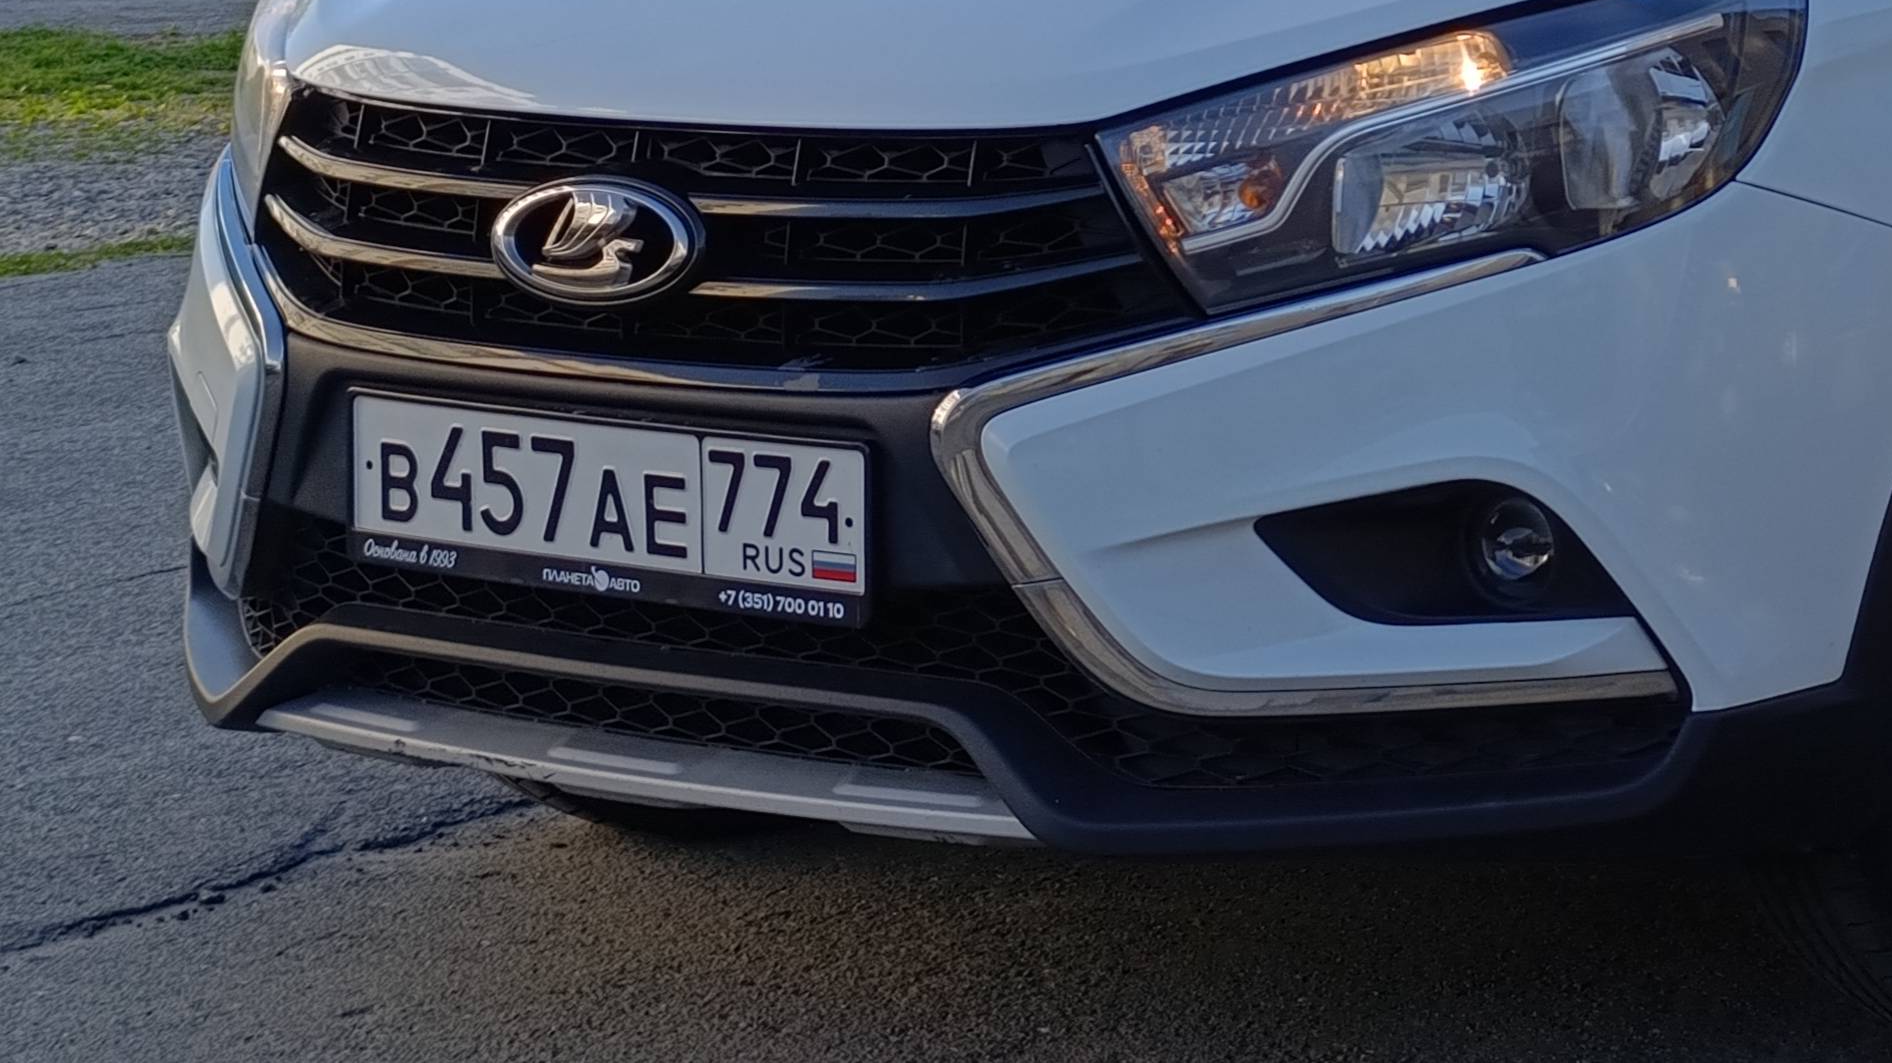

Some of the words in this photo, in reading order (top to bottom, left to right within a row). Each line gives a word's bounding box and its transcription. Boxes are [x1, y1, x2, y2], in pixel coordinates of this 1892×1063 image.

[380, 426, 688, 559] В457АЕ
[708, 449, 839, 545] 774
[429, 549, 457, 569] 1993
[742, 542, 806, 577] RUS
[542, 567, 595, 587] ПЛАНЕТА
[609, 577, 641, 593] АВТО
[718, 589, 737, 606] +7
[738, 589, 774, 612] (351)
[775, 595, 806, 615] 700
[807, 600, 825, 617] 01
[826, 601, 845, 619] 10
